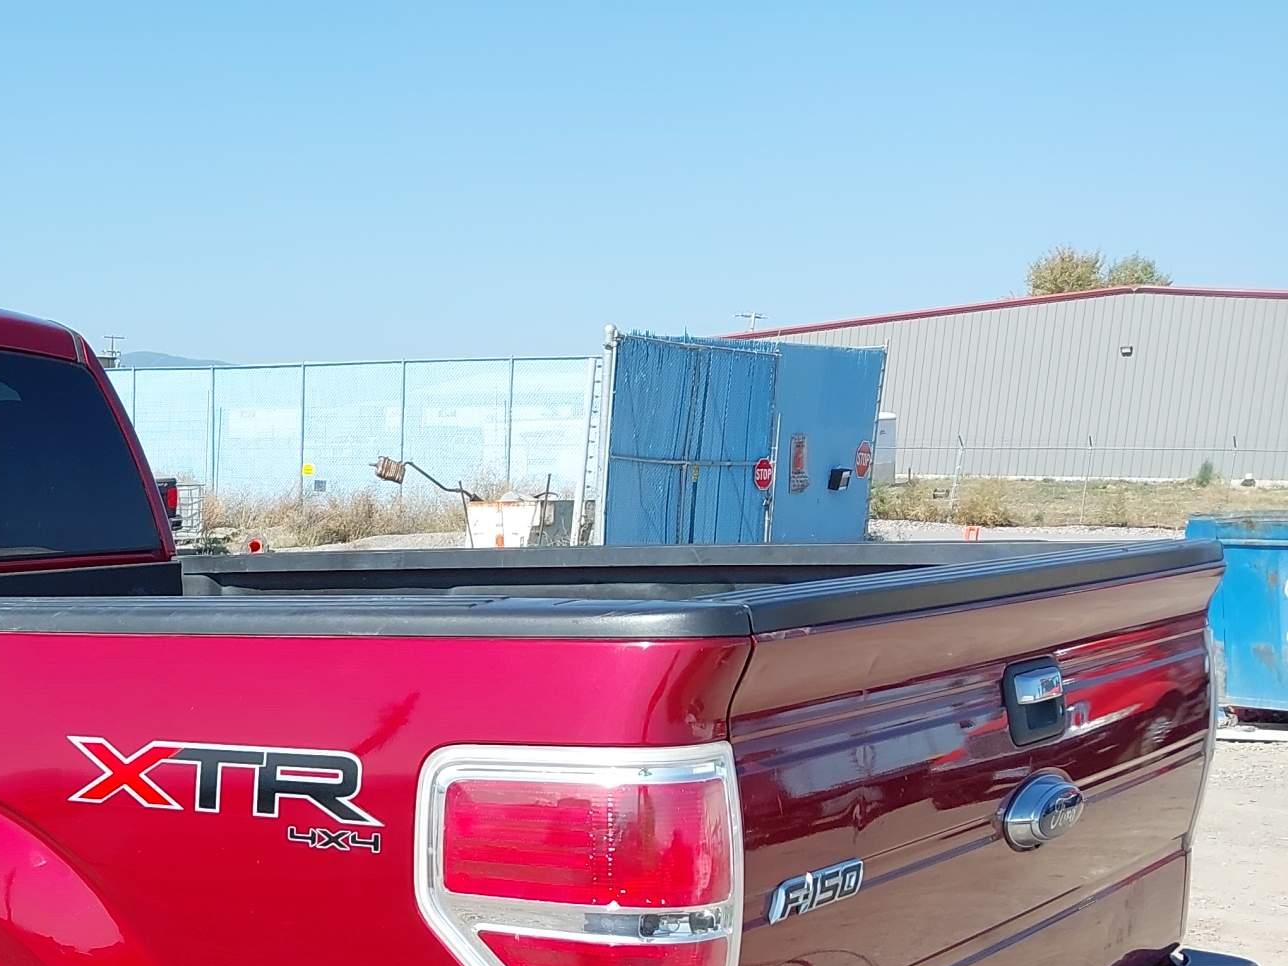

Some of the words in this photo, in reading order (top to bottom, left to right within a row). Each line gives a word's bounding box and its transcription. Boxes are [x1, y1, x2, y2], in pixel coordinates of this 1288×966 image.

[855, 452, 871, 466] STOP
[755, 468, 772, 481] STOP
[66, 735, 386, 827] XTR
[1050, 793, 1078, 830] Ford
